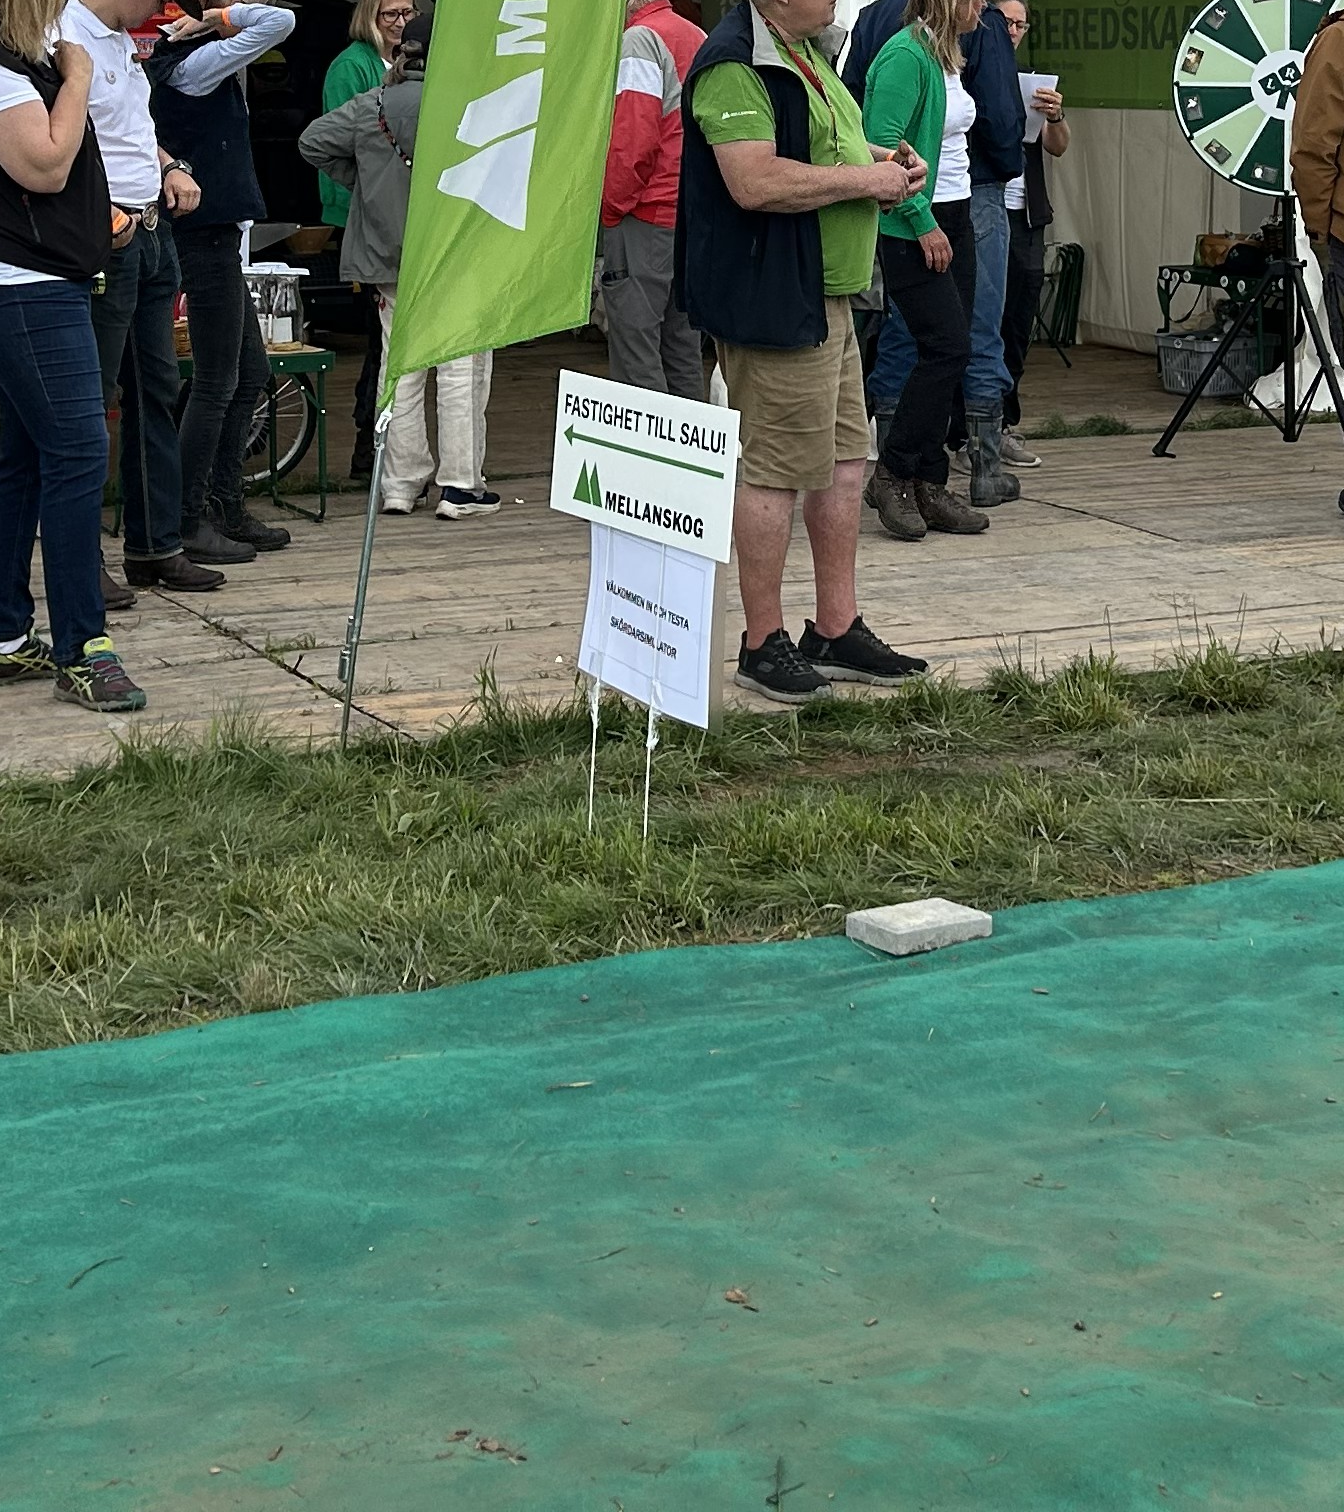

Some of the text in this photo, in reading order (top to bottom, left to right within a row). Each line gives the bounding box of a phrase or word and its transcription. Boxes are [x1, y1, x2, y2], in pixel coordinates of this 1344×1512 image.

[564, 393, 726, 455] FASTIGHET TILL SALU!
[604, 490, 704, 539] MELLANSKOG
[668, 610, 690, 631] TESTA
